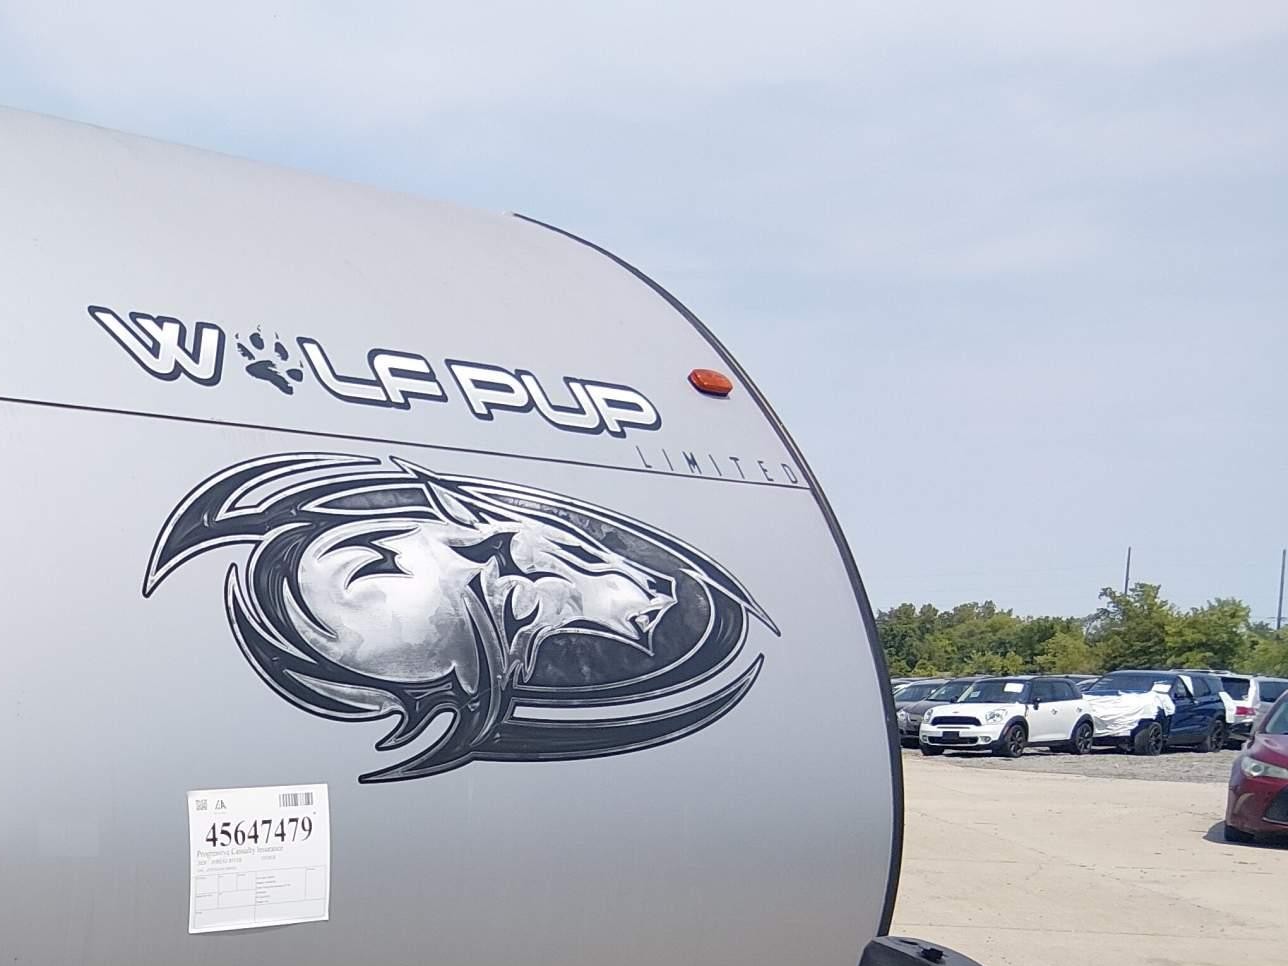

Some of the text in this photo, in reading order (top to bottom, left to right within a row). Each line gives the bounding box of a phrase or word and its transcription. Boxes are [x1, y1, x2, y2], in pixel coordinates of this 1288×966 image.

[88, 305, 661, 437] WLF PUP
[635, 445, 799, 484] LIMITED
[205, 816, 313, 847] 45647479
